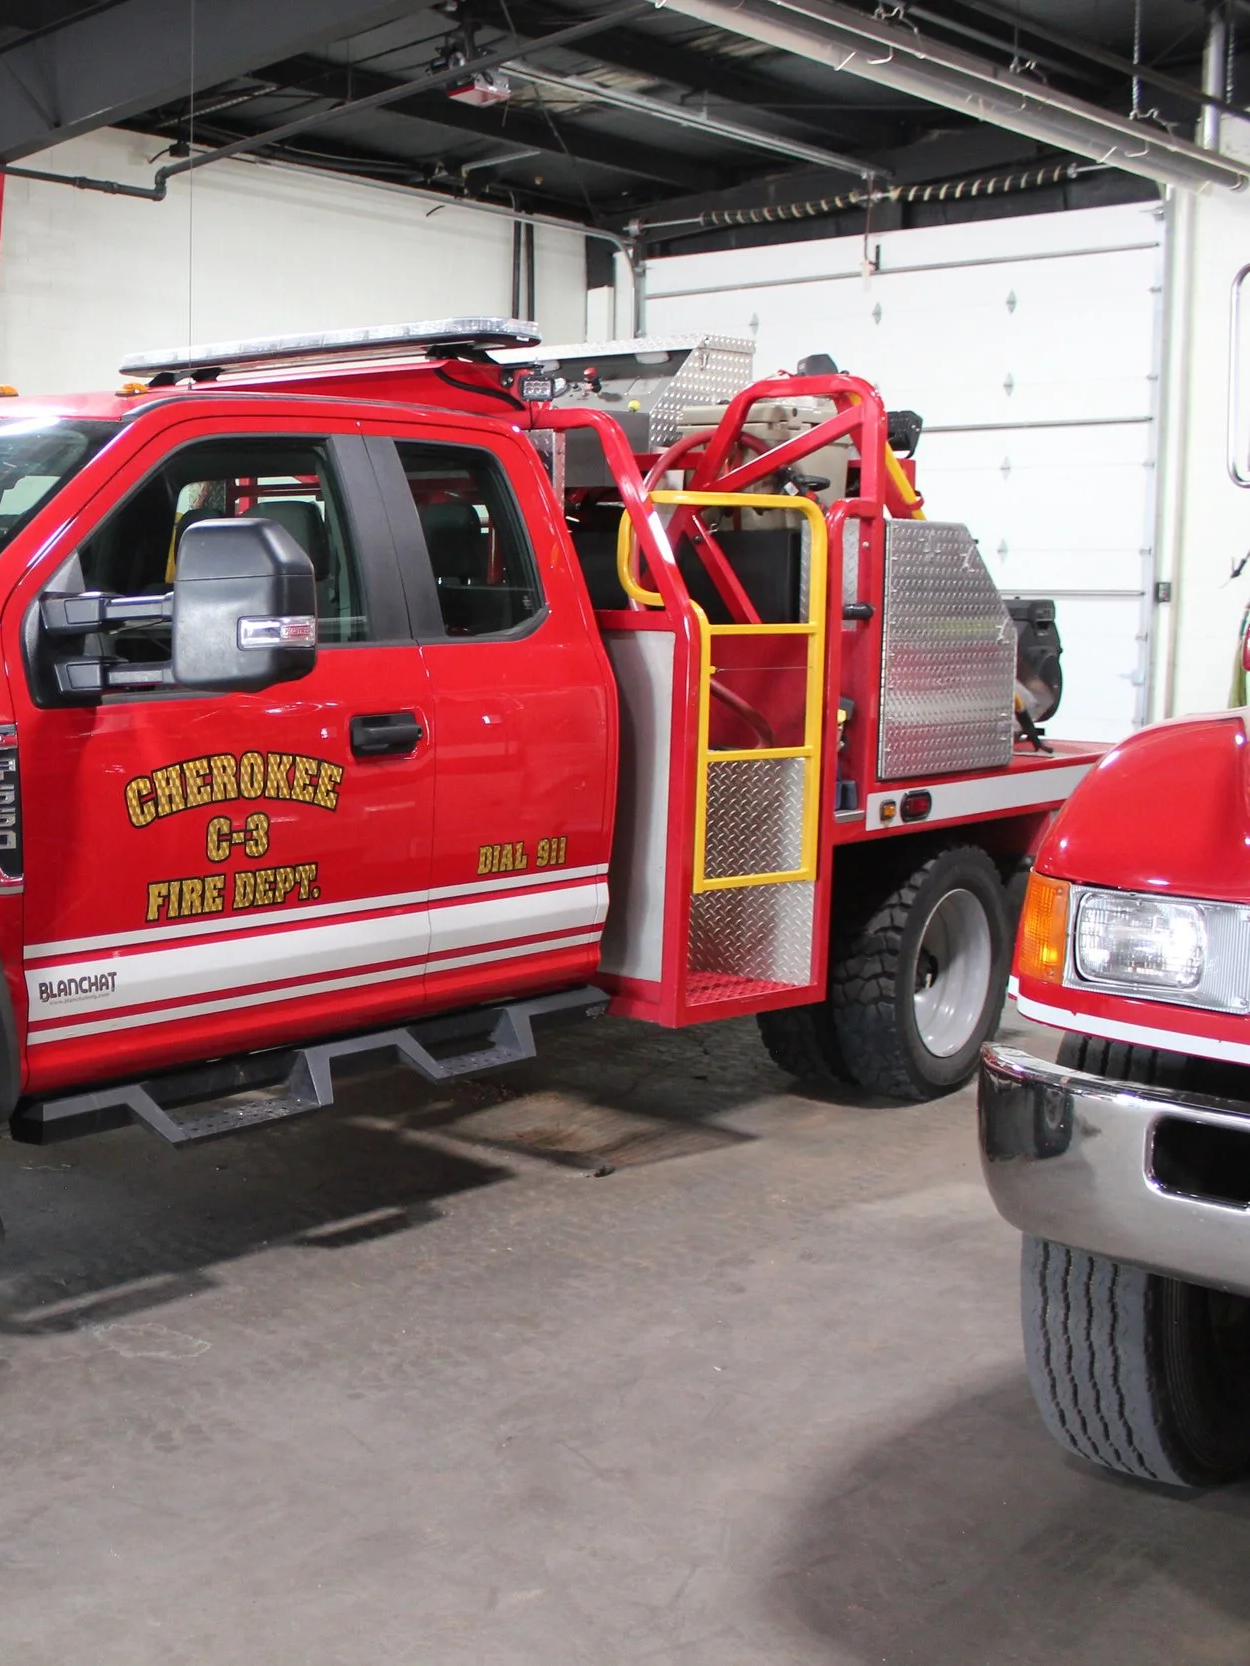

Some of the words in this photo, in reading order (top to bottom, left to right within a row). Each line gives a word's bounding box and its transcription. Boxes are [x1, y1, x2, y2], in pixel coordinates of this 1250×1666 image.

[125, 750, 344, 829] CHEROKEE
[206, 811, 270, 863] C-3
[477, 841, 528, 876] DIAL
[536, 836, 568, 868] 911
[145, 874, 226, 922] FIRE
[232, 862, 321, 910] DEPT.
[38, 971, 117, 1003] BLANCHAT
